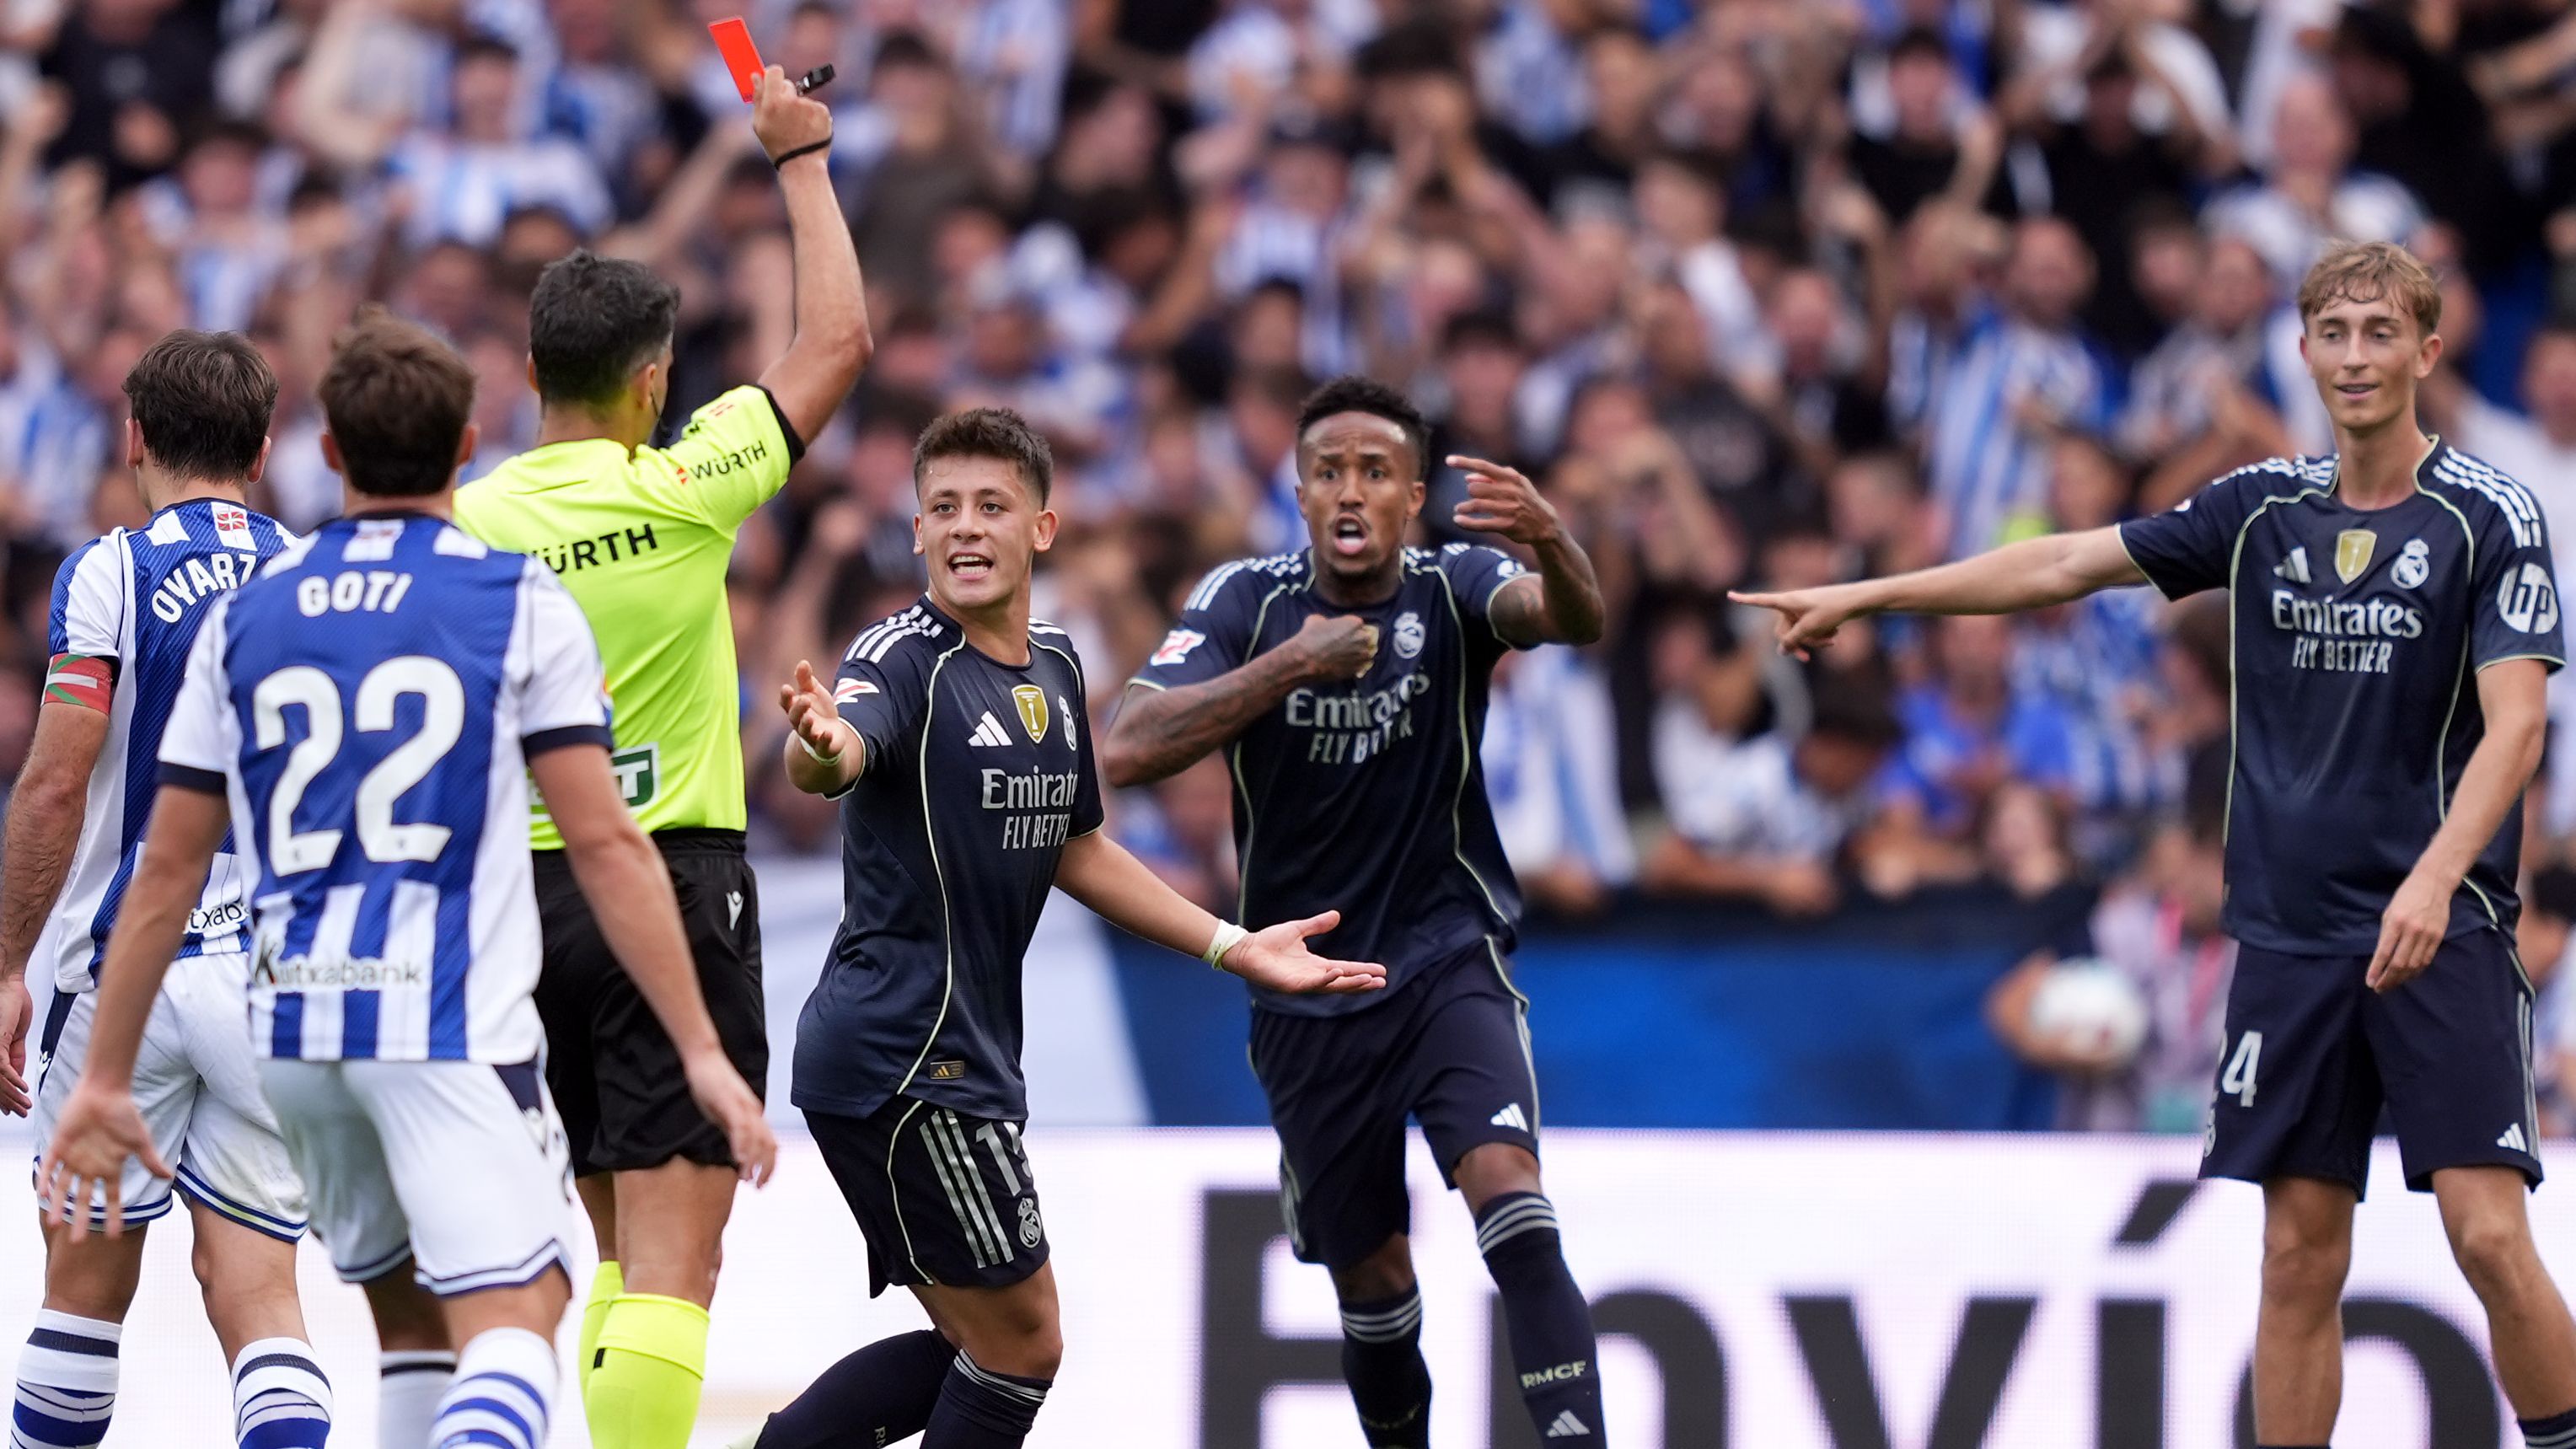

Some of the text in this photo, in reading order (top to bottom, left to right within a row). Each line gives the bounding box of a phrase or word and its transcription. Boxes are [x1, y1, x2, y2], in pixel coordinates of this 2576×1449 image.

[690, 441, 766, 480] WÜRTH
[534, 523, 658, 576] ÜRTH
[298, 572, 412, 617] GOTI
[2273, 590, 2423, 638] Emirates
[2292, 636, 2393, 674] FLY BETTER
[255, 655, 465, 877] 22
[1308, 733, 1350, 765] FLY
[1002, 815, 1031, 850] FLY
[1521, 1360, 1586, 1388] RMCF
